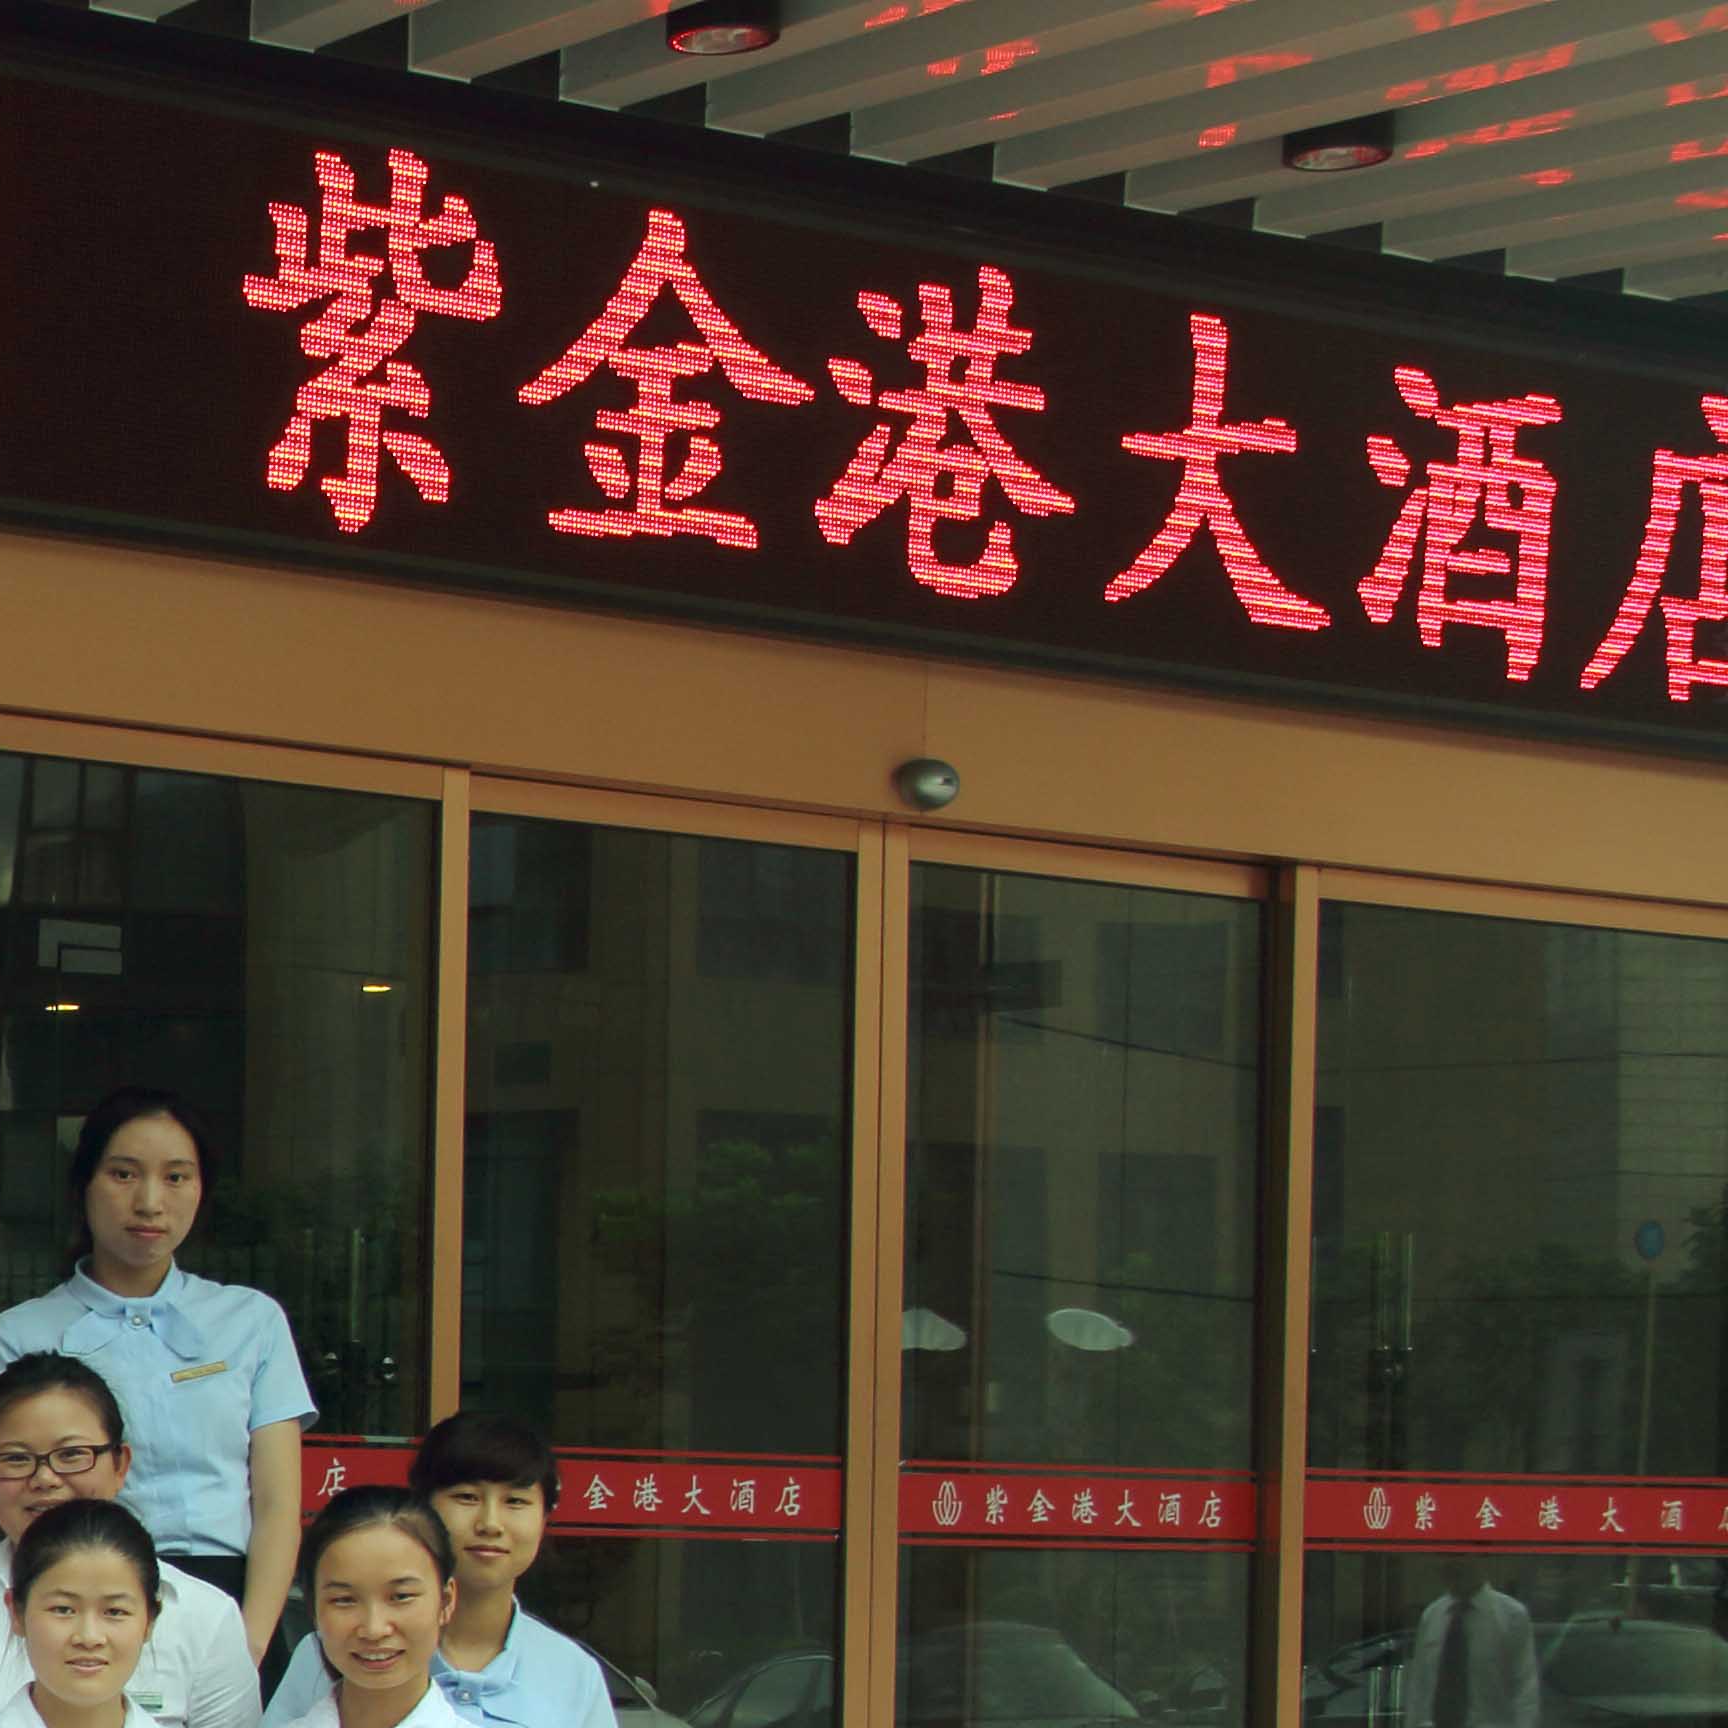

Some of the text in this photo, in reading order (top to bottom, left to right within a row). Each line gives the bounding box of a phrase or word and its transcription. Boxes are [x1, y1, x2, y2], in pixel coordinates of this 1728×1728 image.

[554, 1472, 802, 1518] 金港大酒店
[984, 1483, 1224, 1529] 紫金港大酒店
